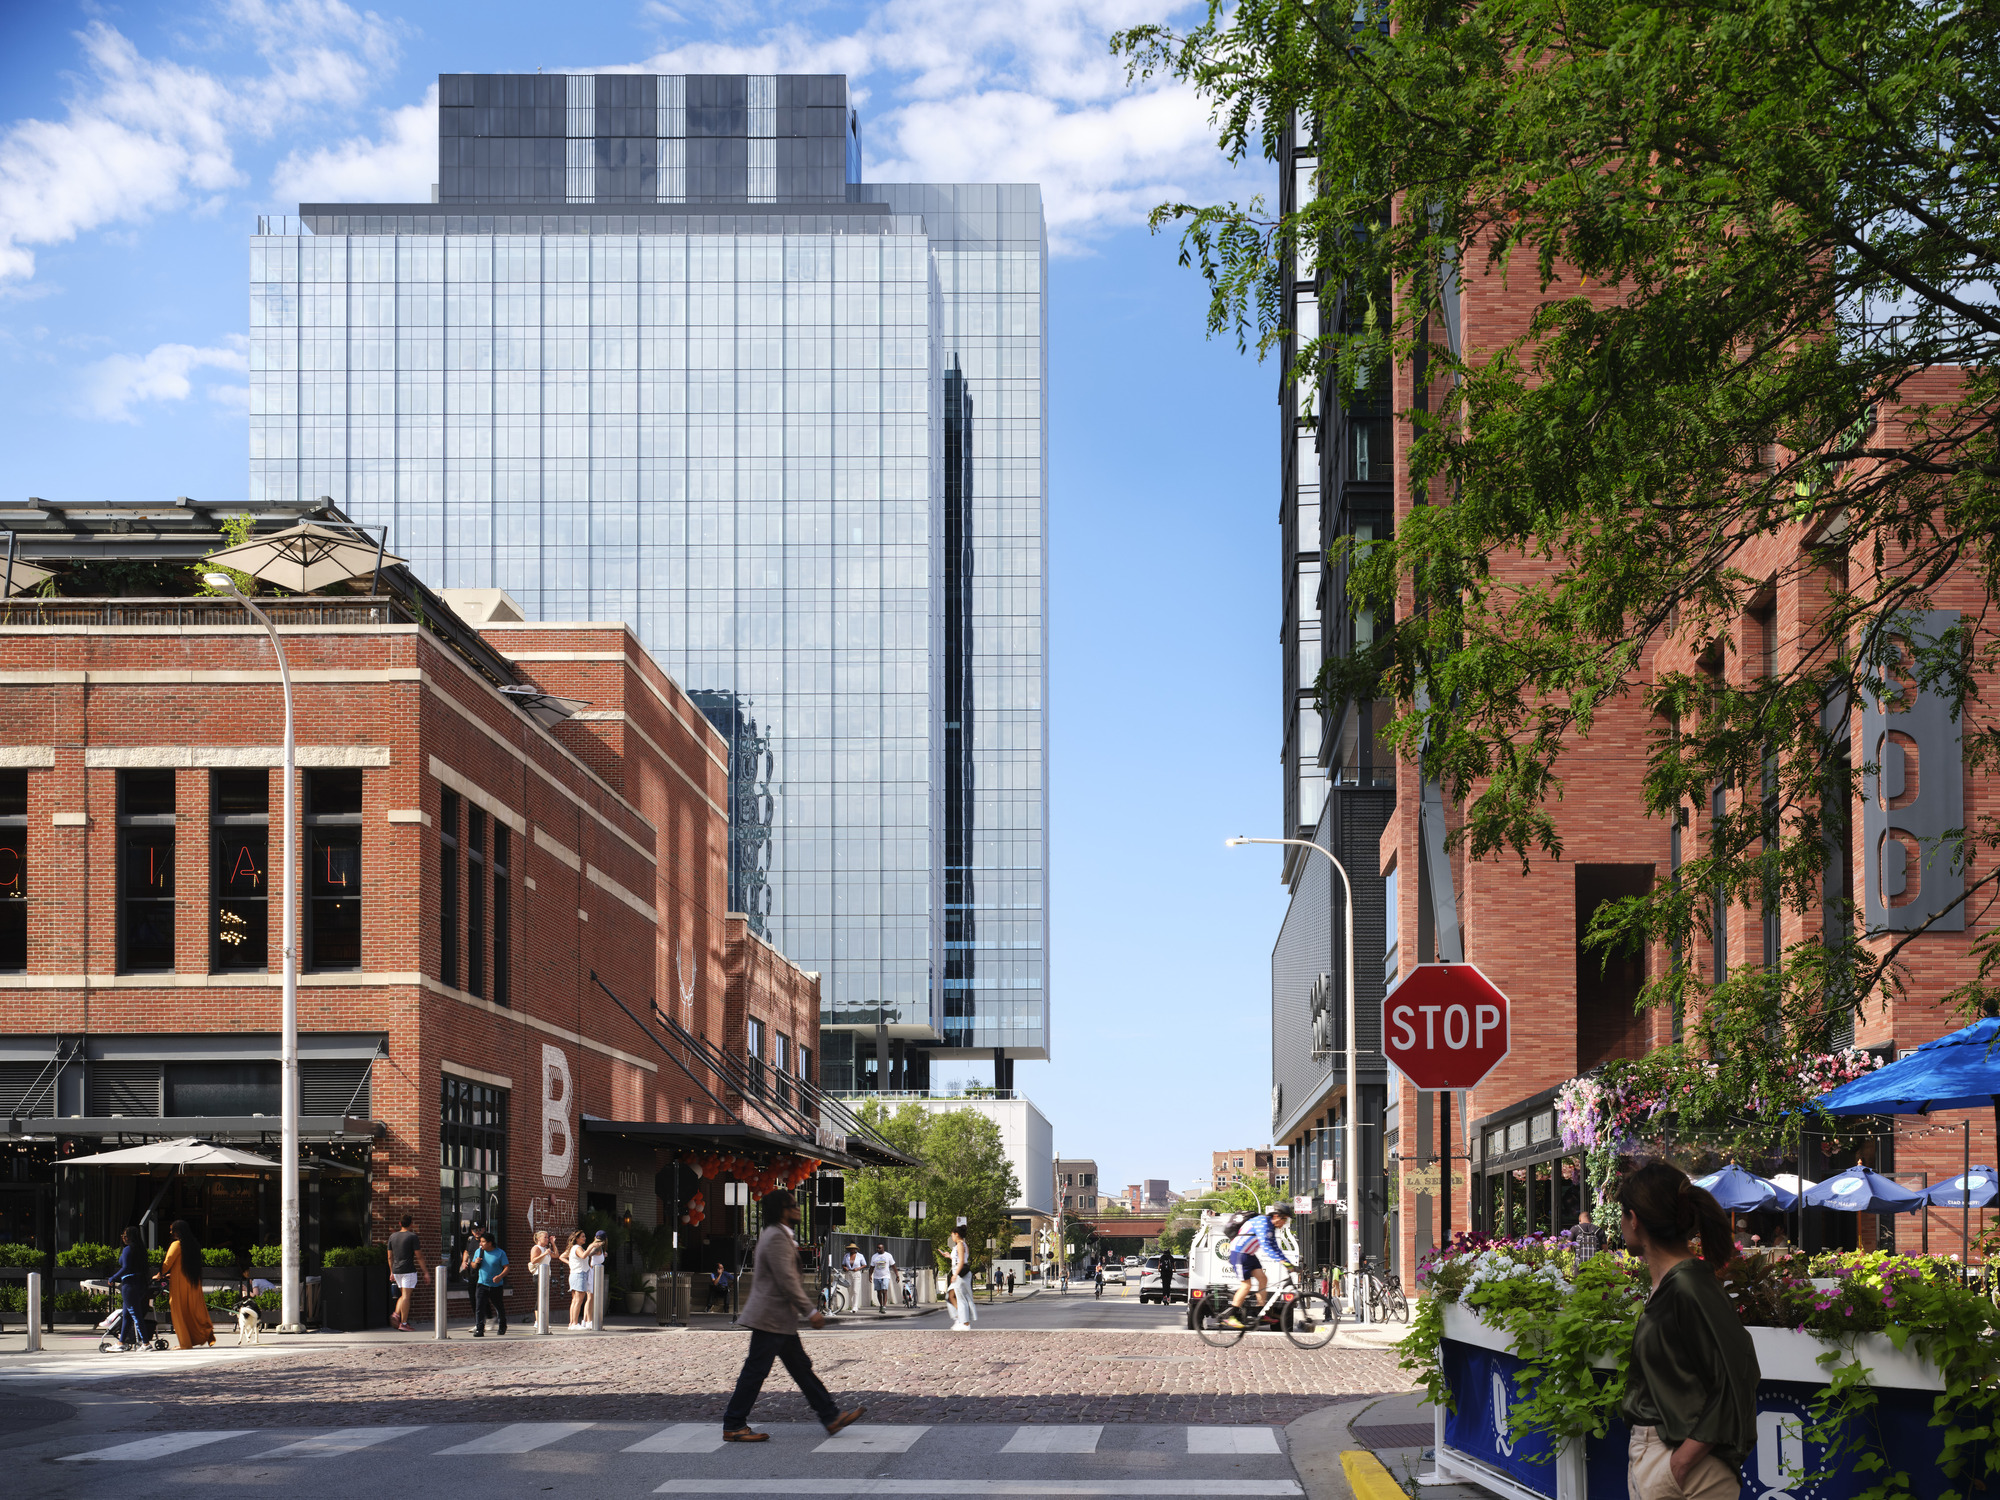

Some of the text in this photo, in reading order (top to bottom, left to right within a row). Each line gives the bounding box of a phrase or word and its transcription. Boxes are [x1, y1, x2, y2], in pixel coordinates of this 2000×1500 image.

[1391, 1004, 1501, 1051] STOP
[541, 1043, 574, 1188] B
[1406, 1177, 1421, 1186] LA
[535, 1196, 576, 1225] BEATRIX
